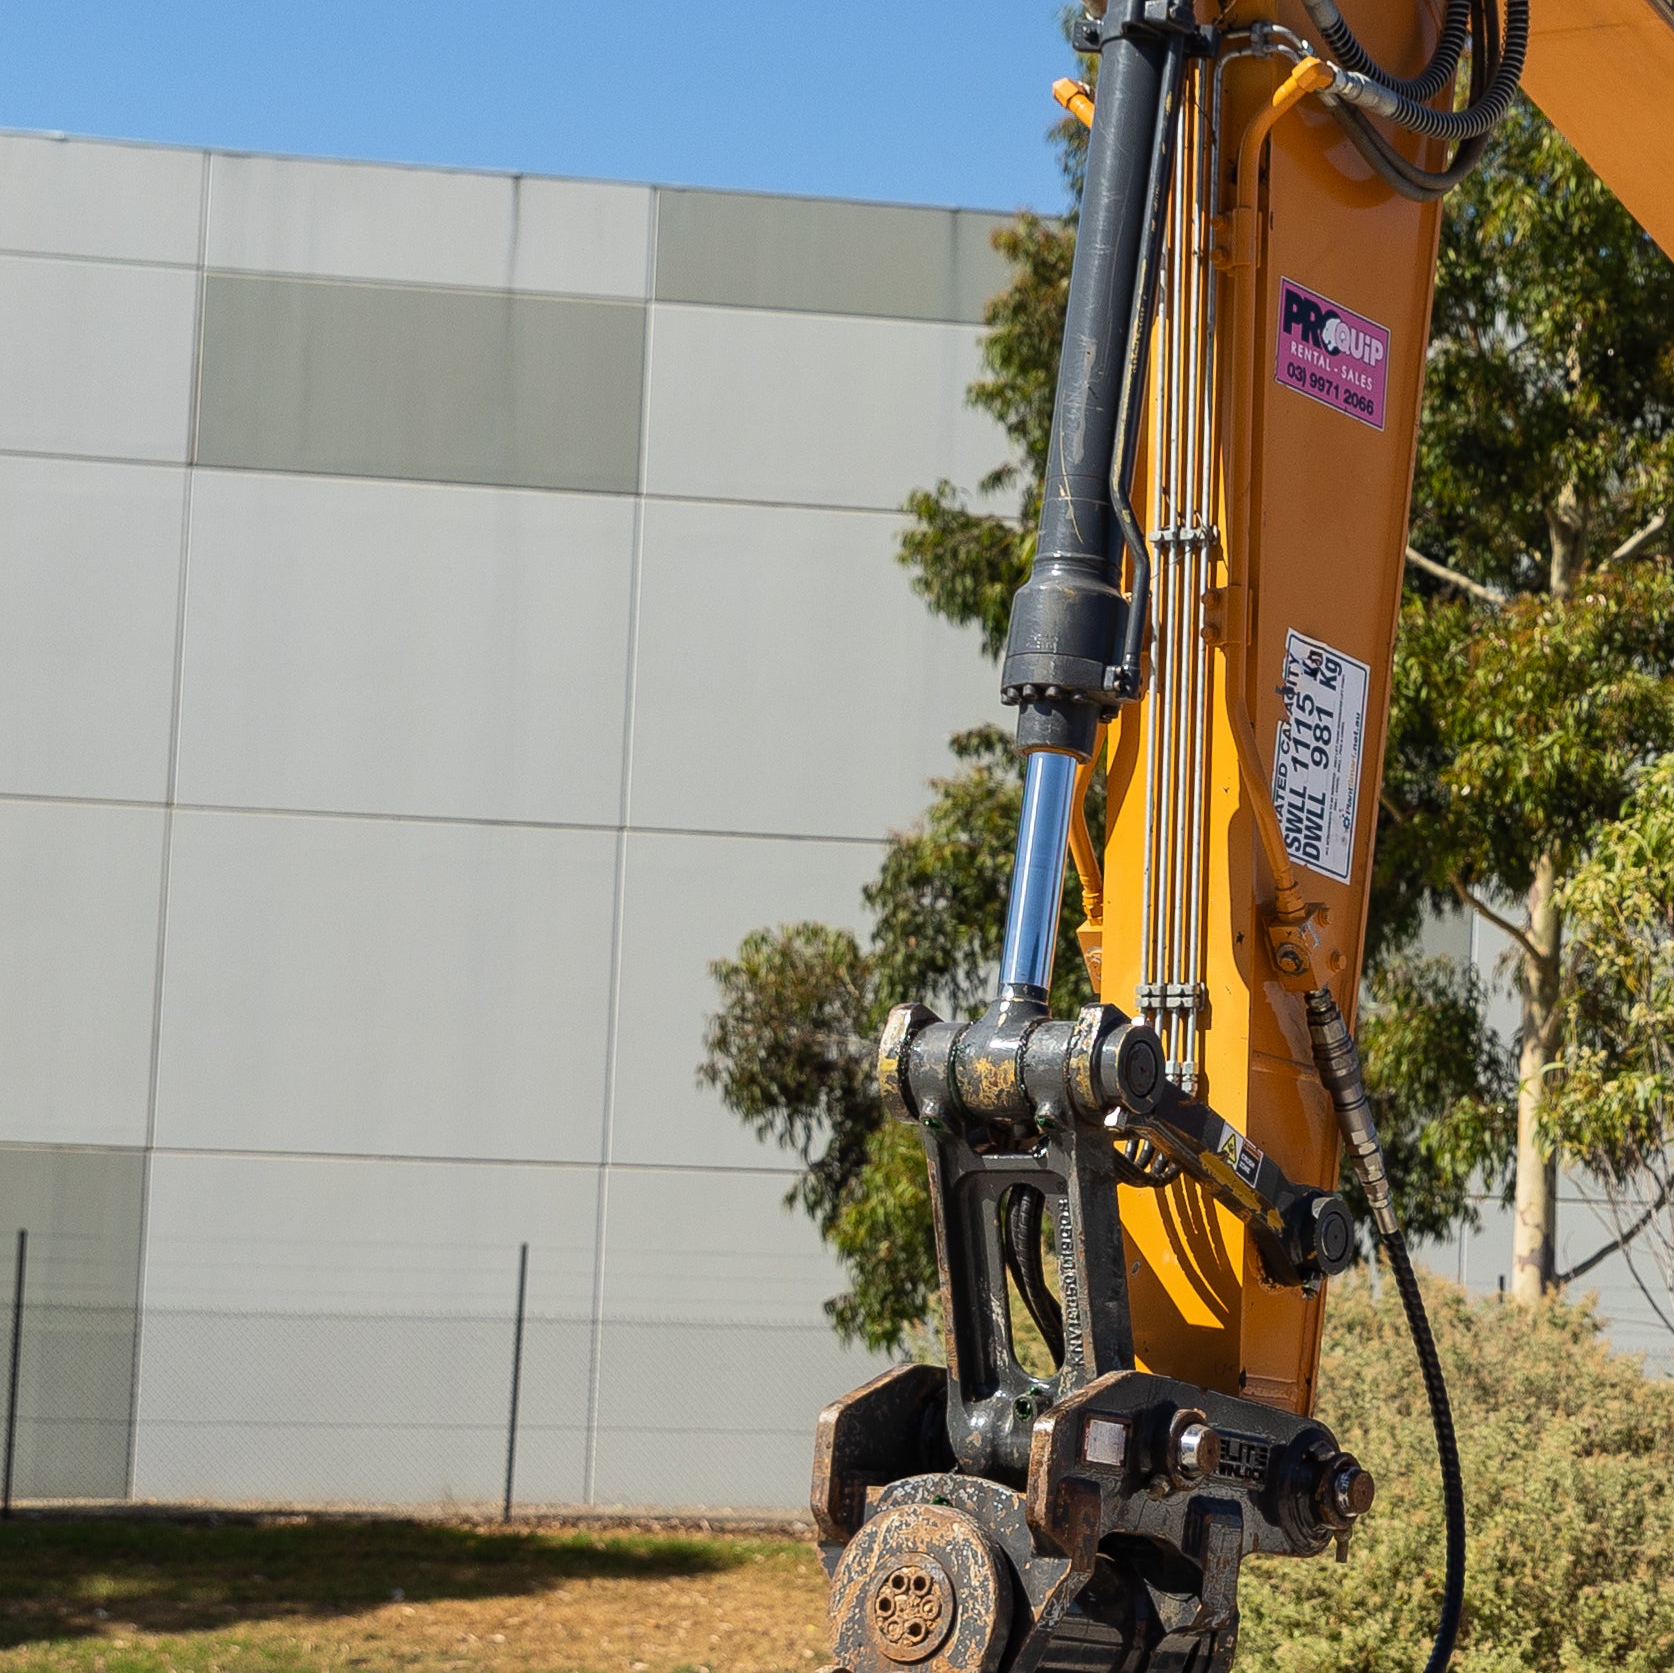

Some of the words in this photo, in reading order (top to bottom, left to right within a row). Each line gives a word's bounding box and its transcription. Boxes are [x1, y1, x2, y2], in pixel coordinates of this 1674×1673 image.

[1287, 362, 1306, 387] 03)
[1309, 372, 1339, 399] 9971
[1343, 388, 1374, 416] 2066
[1290, 340, 1331, 371] RENTAL
[1341, 366, 1373, 391] SALES
[1319, 656, 1343, 692] Kg
[1291, 692, 1315, 772] 1115
[1310, 705, 1334, 770] 981
[1274, 762, 1288, 824] ATED
[1284, 786, 1307, 852] SWLL
[1302, 792, 1326, 862] DWLL
